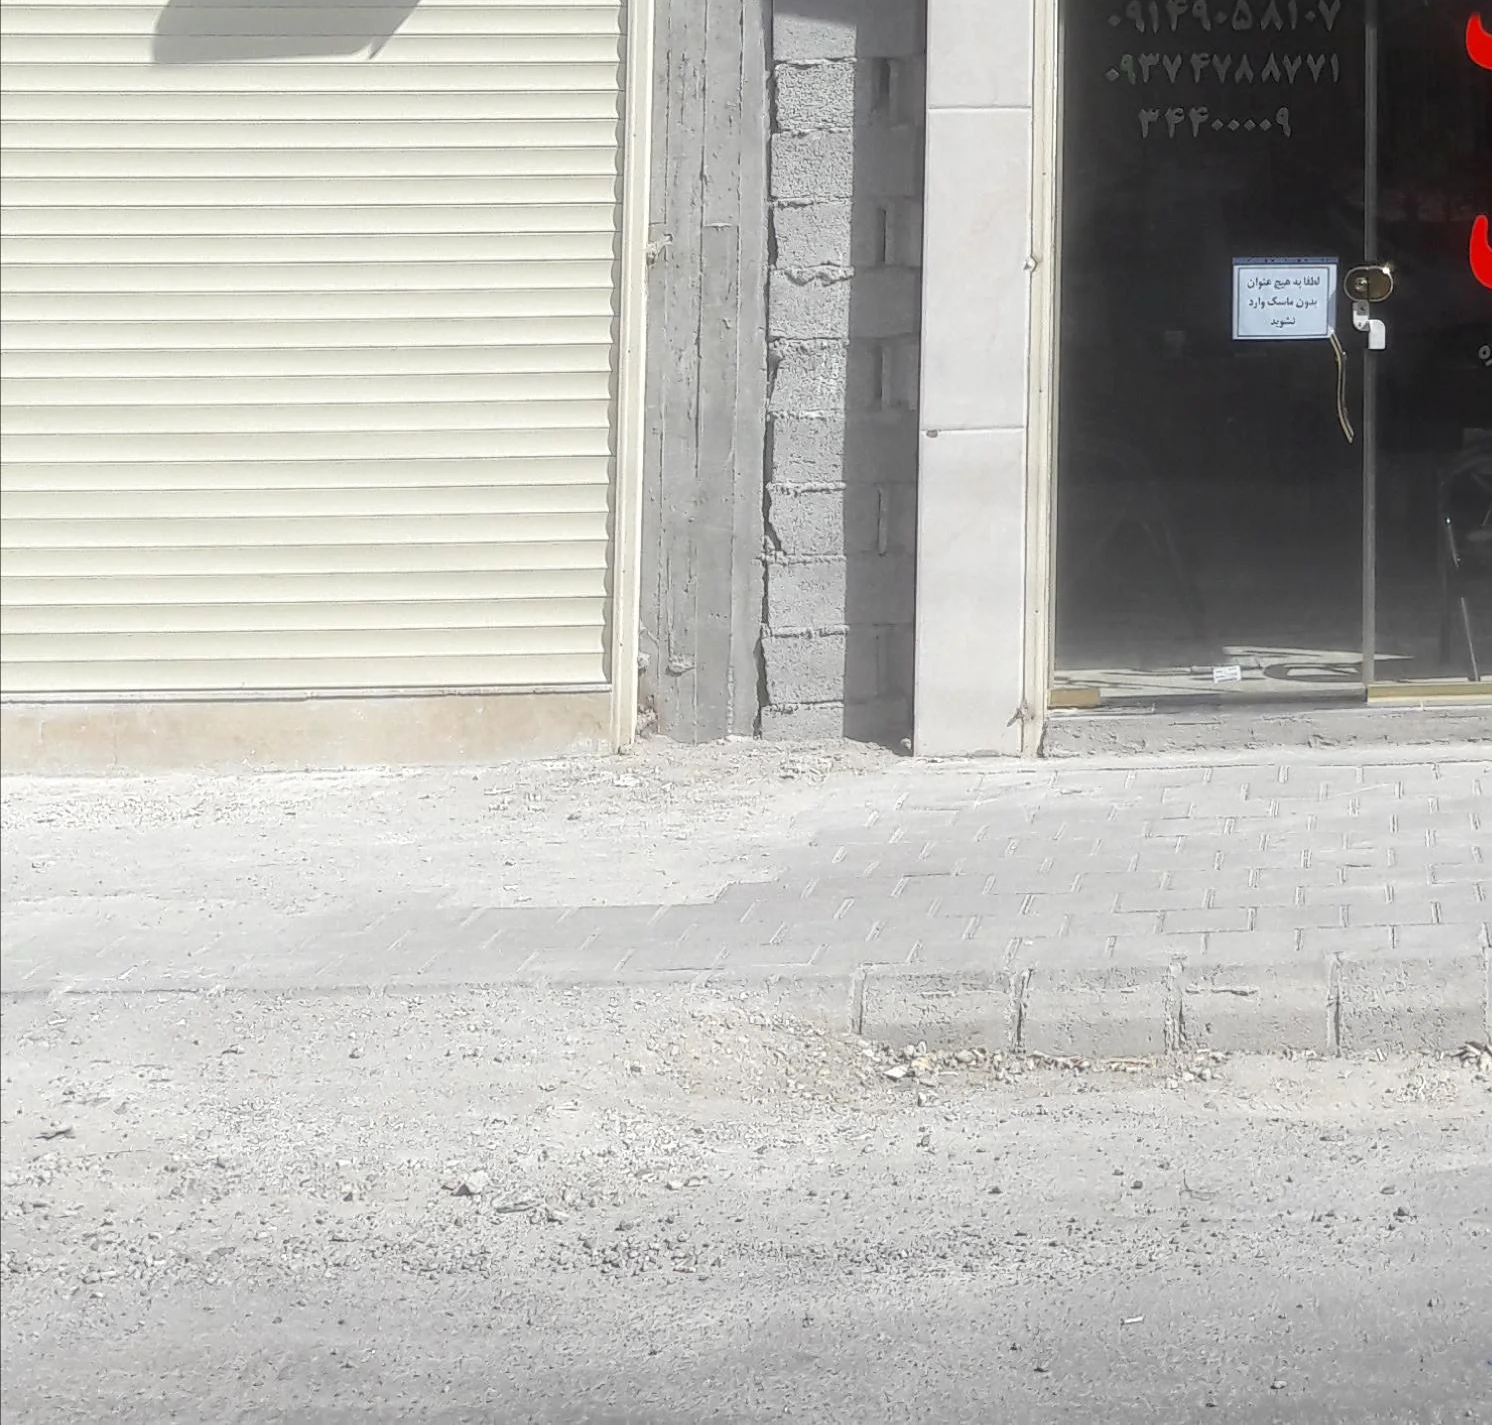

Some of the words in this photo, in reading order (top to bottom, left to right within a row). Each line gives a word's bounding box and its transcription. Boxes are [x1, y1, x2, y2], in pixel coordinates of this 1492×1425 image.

[1247, 277, 1271, 290] عنوان
[1273, 278, 1290, 290] هیچ
[1292, 278, 1301, 289] به
[1303, 275, 1320, 285] لطفا
[1248, 296, 1265, 309] وارد
[1267, 296, 1294, 305] ماسک
[1295, 298, 1318, 309] بدون
[1270, 316, 1296, 328] نشوید
